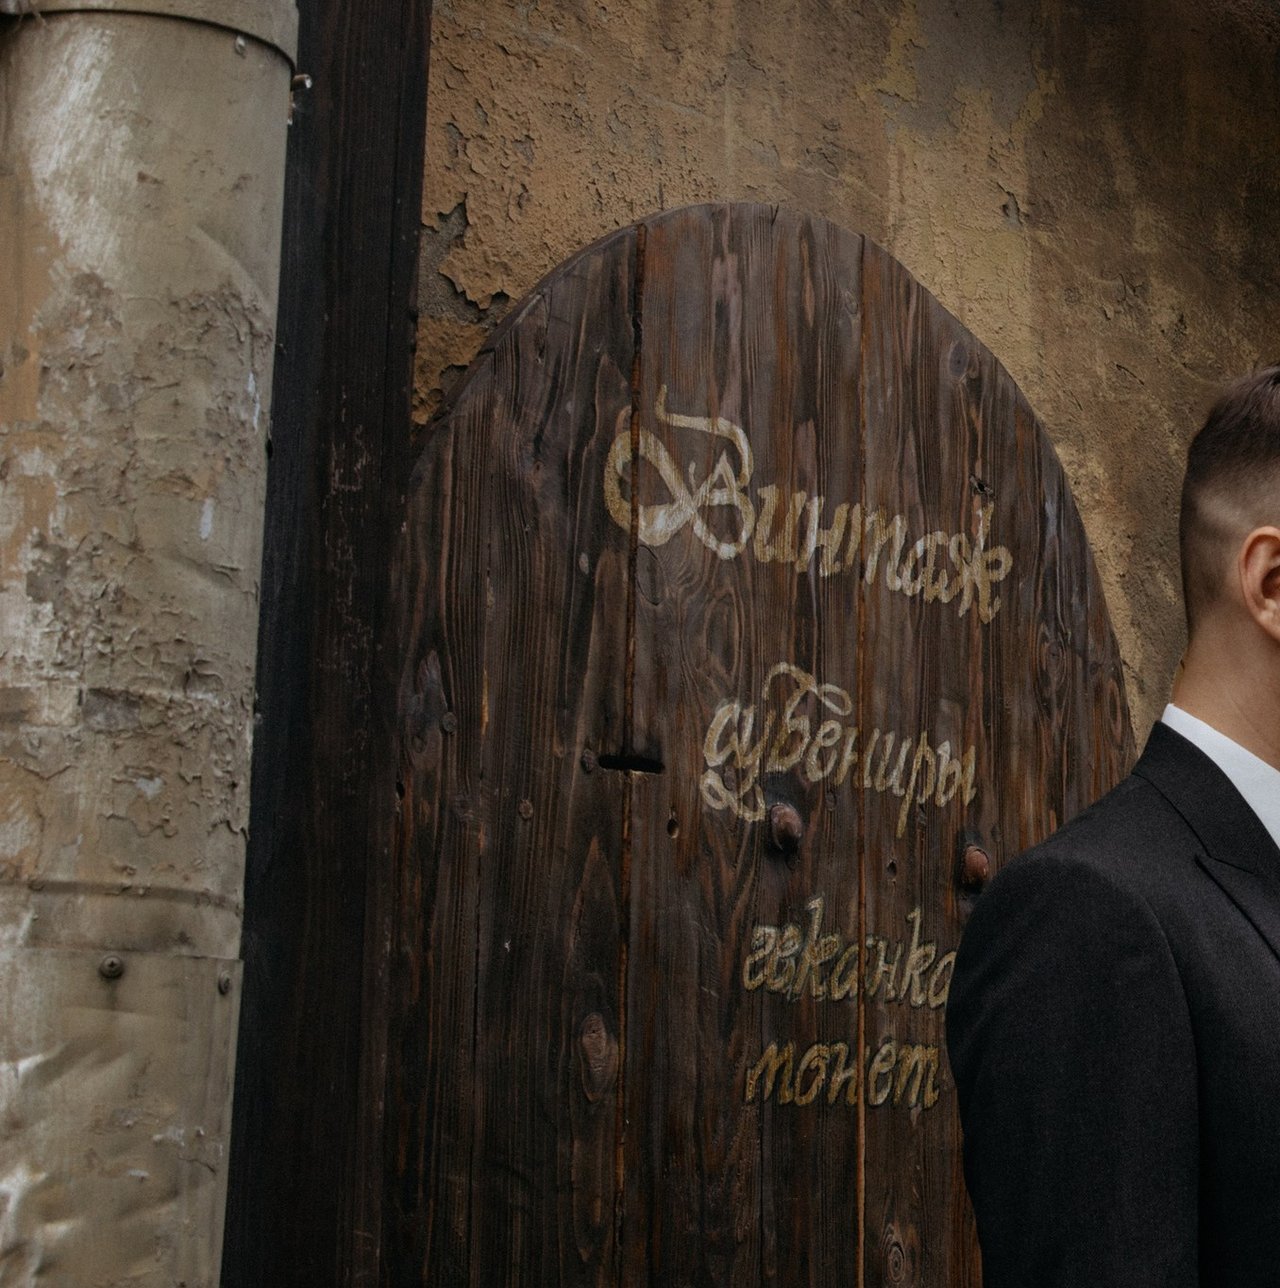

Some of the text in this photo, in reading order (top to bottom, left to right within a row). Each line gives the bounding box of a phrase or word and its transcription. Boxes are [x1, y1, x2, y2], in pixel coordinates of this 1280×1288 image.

[605, 386, 1013, 622] Винтаж
[700, 661, 977, 838] сувениры
[746, 1041, 941, 1108] монет
